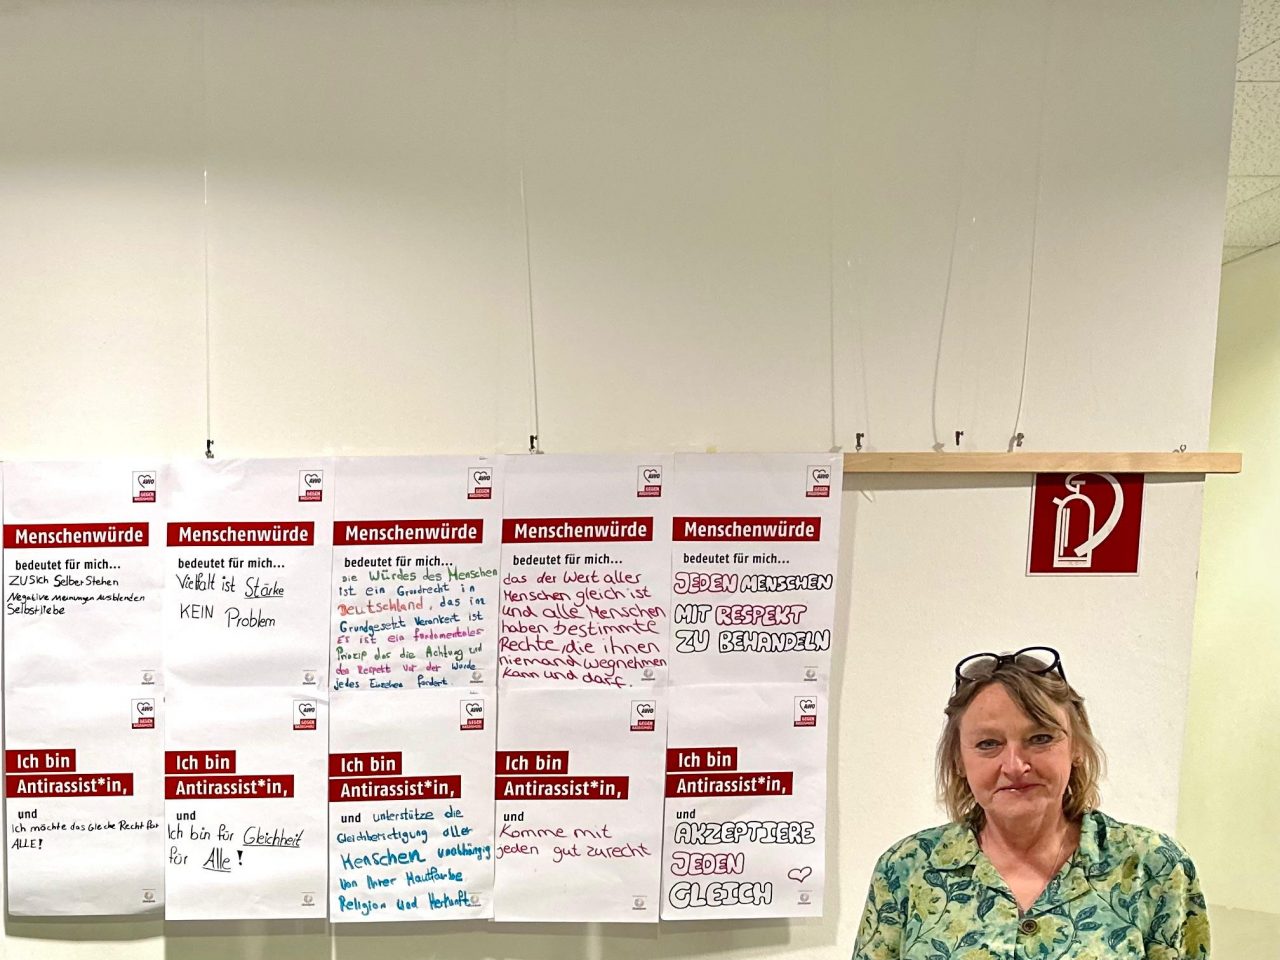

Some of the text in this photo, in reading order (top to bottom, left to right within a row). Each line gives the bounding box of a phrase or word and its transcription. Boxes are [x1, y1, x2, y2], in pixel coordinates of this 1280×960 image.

[15, 526, 143, 544] Menschenwürde
[178, 526, 309, 543] Menschenwürde
[345, 523, 477, 541] Menschenwürde
[514, 521, 647, 539] Menschenwürde
[684, 521, 815, 538] Menschenwürde
[15, 559, 62, 570] bedeutet
[65, 559, 81, 570] für
[178, 558, 225, 569] bedeutet
[228, 557, 245, 569] für
[344, 557, 392, 568] bedeutet
[396, 556, 411, 567] für
[513, 554, 561, 566] bedeutet
[565, 554, 581, 565] für
[683, 553, 730, 564] bedeutet
[733, 553, 748, 564] für
[422, 568, 442, 582] des
[563, 569, 642, 584] Wert aller
[673, 572, 833, 594] JEDEN MENSCHEN
[175, 573, 285, 597] Vielfalt ist Stärke
[365, 586, 386, 596] ein
[439, 598, 461, 607] das
[576, 586, 652, 607] gleich ist
[7, 604, 66, 616] Selbstliebe
[180, 603, 275, 628] KEIN Problem
[502, 604, 538, 618] und
[674, 603, 807, 626] MIT RESPEKT
[501, 619, 660, 637] haben bestimmte
[602, 636, 661, 656] ihnen
[675, 629, 831, 654] ZU BEHANDELN
[17, 753, 70, 769] Ich bin
[176, 755, 230, 770] Ich bin
[341, 756, 396, 773] Ich bin
[505, 755, 562, 771] Ich bin
[678, 751, 732, 768] Ich bin
[17, 809, 37, 819] und
[176, 810, 196, 821] und
[340, 813, 361, 823] und
[444, 805, 464, 818] die
[503, 811, 524, 822] und
[676, 808, 696, 819] und
[30, 821, 144, 832] möchte das Recht
[168, 823, 184, 840] Ich
[190, 823, 211, 841] bin
[216, 824, 234, 842] für
[574, 824, 612, 838] mit
[674, 821, 816, 845] AKZEPTIERE
[169, 846, 188, 865] für
[552, 843, 585, 863] gut
[671, 851, 745, 876] JEDEN
[669, 881, 773, 909] GLEICH
[339, 894, 386, 916] Religion
